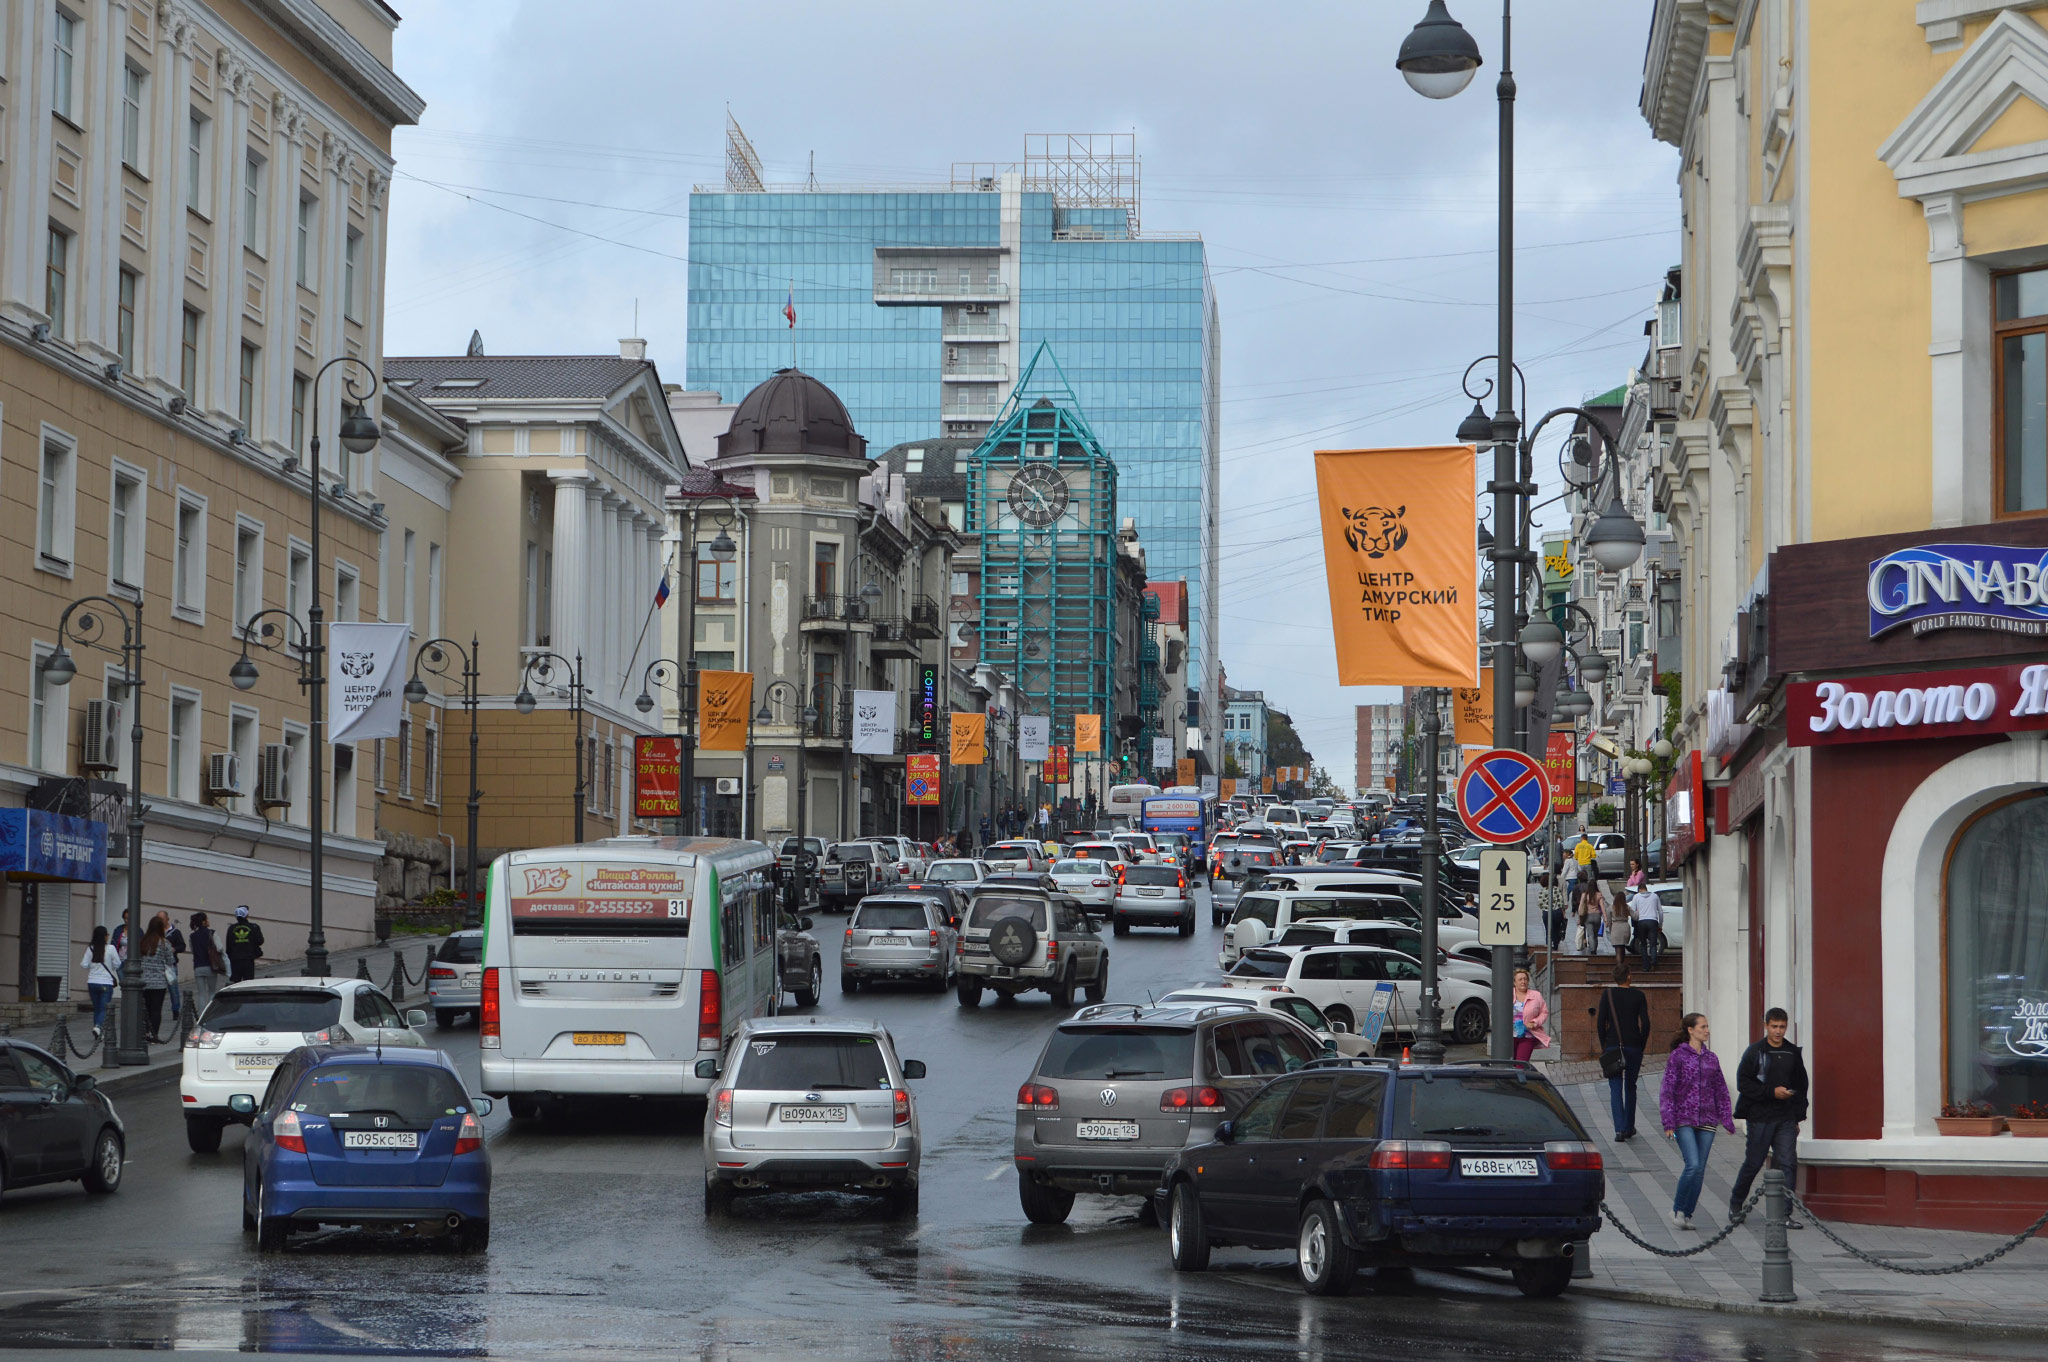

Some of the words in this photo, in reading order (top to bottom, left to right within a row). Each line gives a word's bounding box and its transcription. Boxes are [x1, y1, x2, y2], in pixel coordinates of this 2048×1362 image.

[1357, 572, 1414, 587] ЦЕНТР
[1361, 586, 1457, 606] АМУРСКИЙ
[1362, 607, 1401, 623] ТИГР
[1912, 616, 1945, 634] WORLD
[1949, 615, 1986, 628] FAMOUS
[1990, 617, 2040, 634] CINNAMON
[344, 685, 376, 693] ЦЕНТР
[924, 670, 933, 709] COFFEE
[1810, 681, 1996, 732] Золото
[2010, 664, 2048, 717] Я
[344, 704, 368, 712] ТИГР
[923, 712, 932, 739] CLUB
[640, 764, 679, 774] 297-16-16
[640, 798, 679, 811] НОГТЕЙ
[56, 842, 94, 863] ТРЕПАНГ
[588, 880, 646, 890] +Китайская
[648, 881, 682, 892] кухня!
[530, 903, 575, 912] доставка
[670, 900, 684, 916] 31
[1490, 893, 1515, 911] 25
[548, 971, 652, 981] HYUNDAI
[239, 1056, 273, 1066] Н665ВС
[785, 1108, 826, 1119] В090АХ
[827, 1108, 843, 1117] 125
[1080, 1125, 1119, 1137] Е990АЕ
[1121, 1125, 1136, 1135] 125
[349, 1133, 395, 1146] Т095КС
[397, 1133, 414, 1143] 125
[1467, 1159, 1514, 1174] У688ЕК
[1516, 1159, 1533, 1170] 125
